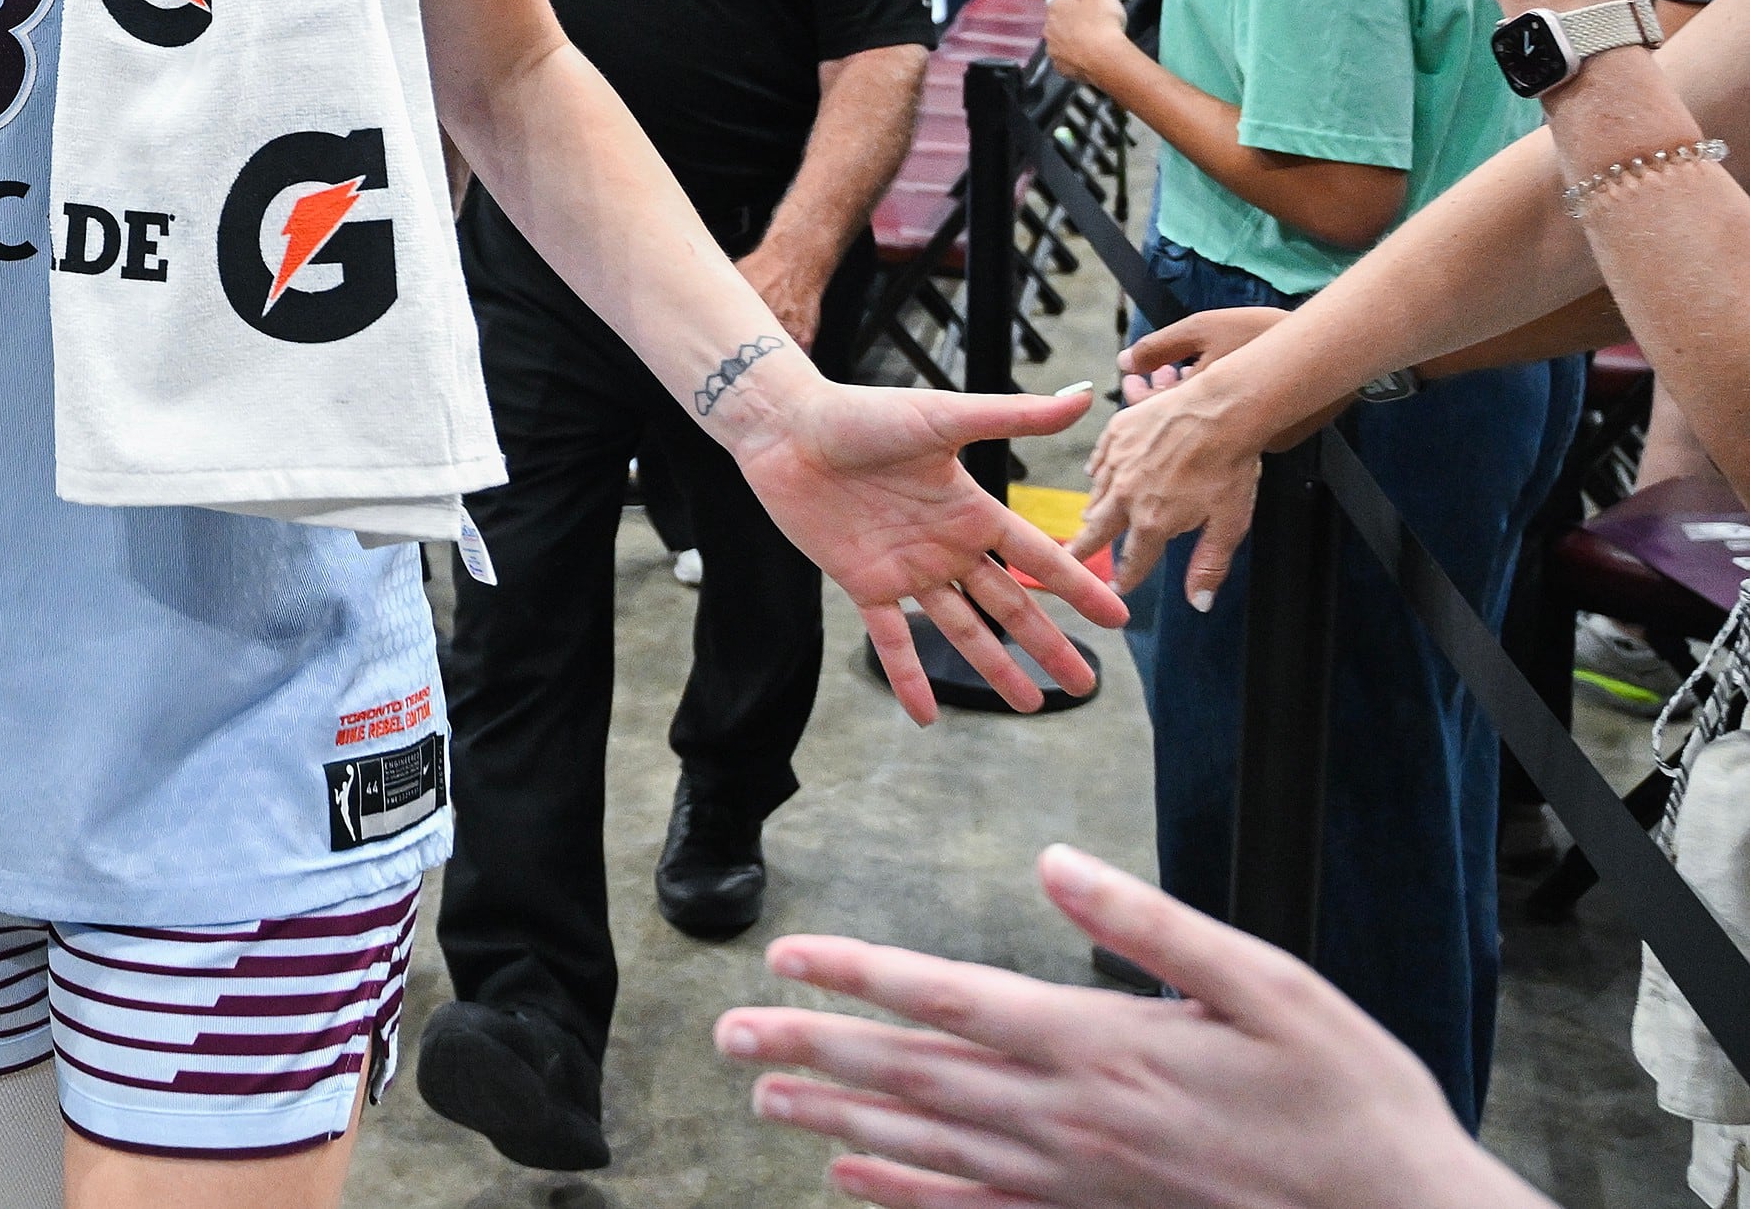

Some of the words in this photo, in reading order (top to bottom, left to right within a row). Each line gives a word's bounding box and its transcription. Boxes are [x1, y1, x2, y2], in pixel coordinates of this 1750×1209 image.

[217, 127, 399, 344] G
[340, 700, 403, 726] TORONTO
[368, 714, 405, 740] REBEL
[366, 780, 379, 796] 44
